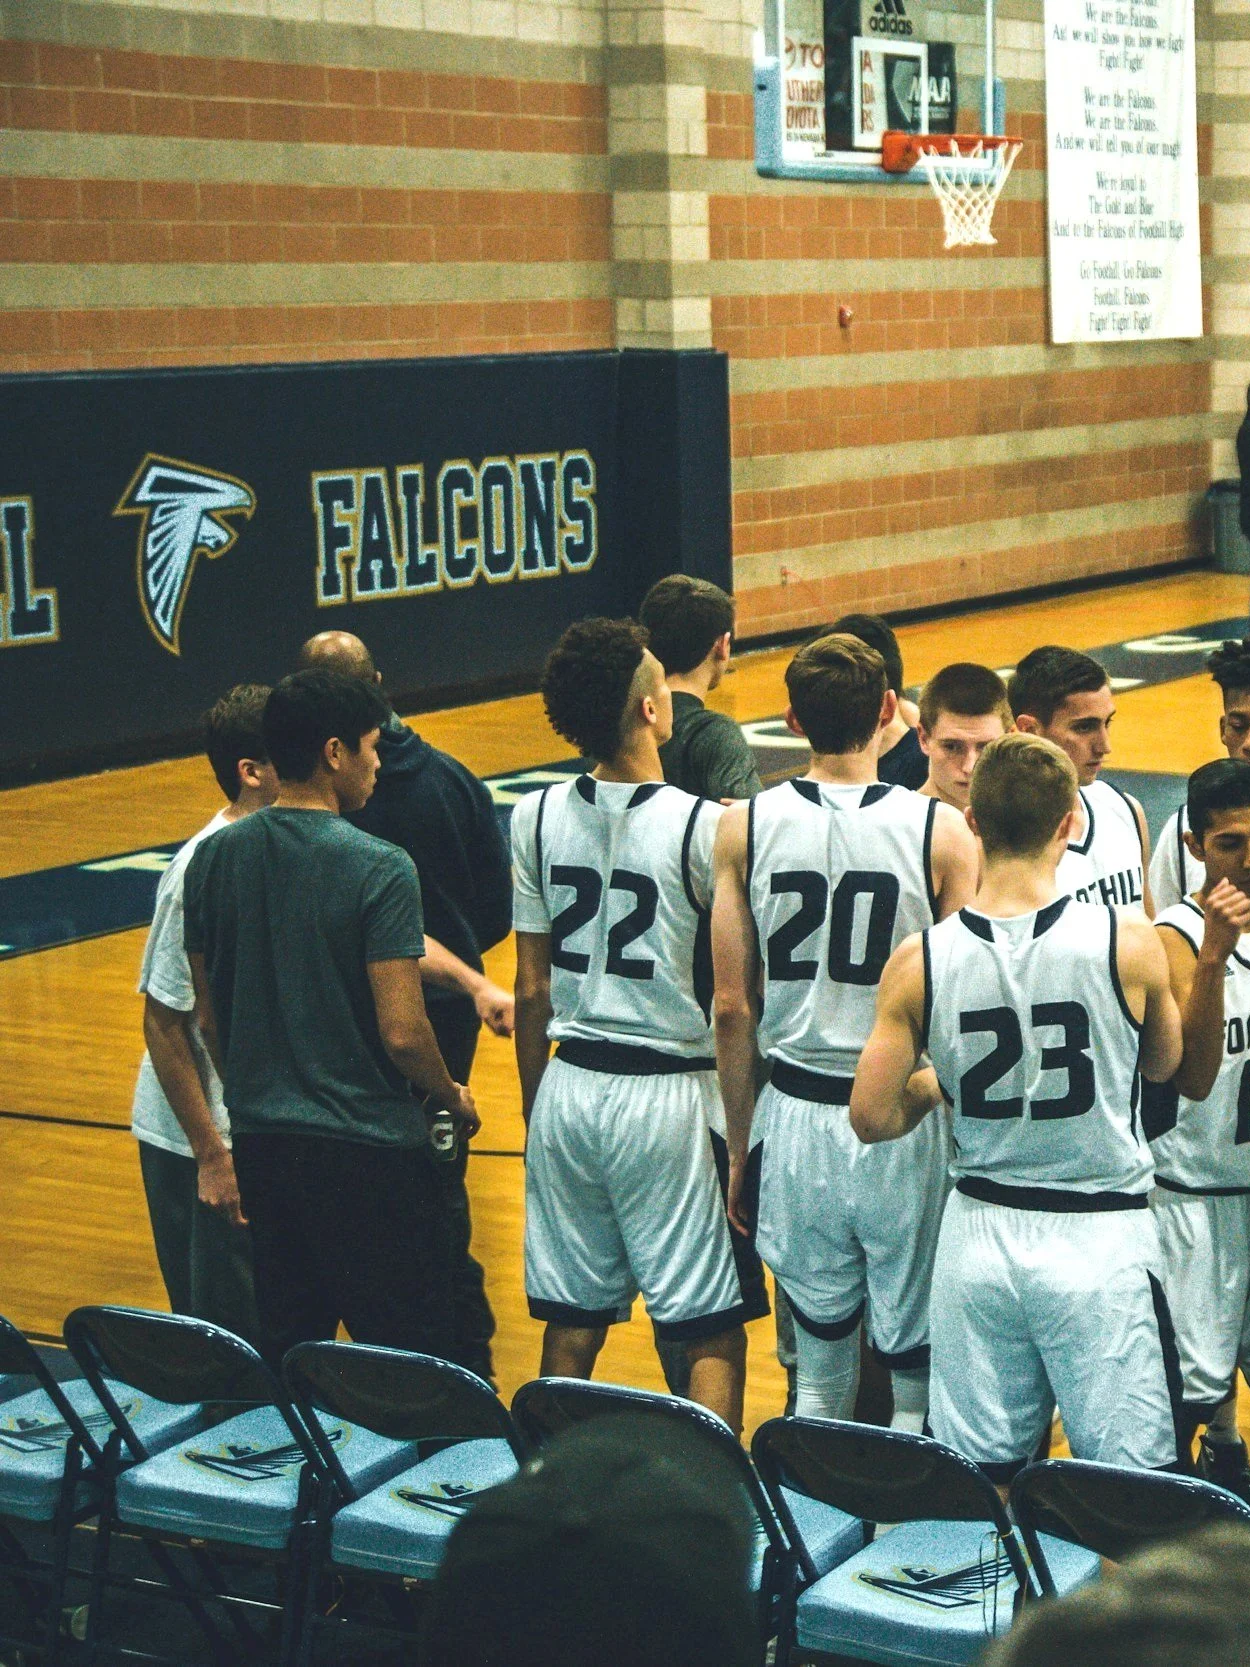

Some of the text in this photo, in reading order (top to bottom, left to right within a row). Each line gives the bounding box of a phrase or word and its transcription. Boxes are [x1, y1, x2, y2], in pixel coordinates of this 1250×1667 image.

[869, 15, 913, 35] adidas
[908, 75, 951, 103] NAA
[1089, 195, 1102, 214] The
[1054, 218, 1069, 236] And
[311, 449, 598, 608] FALCONS
[550, 863, 660, 980] 22
[767, 869, 900, 986] 20
[959, 1000, 1096, 1121] 23
[431, 1122, 454, 1151] G
